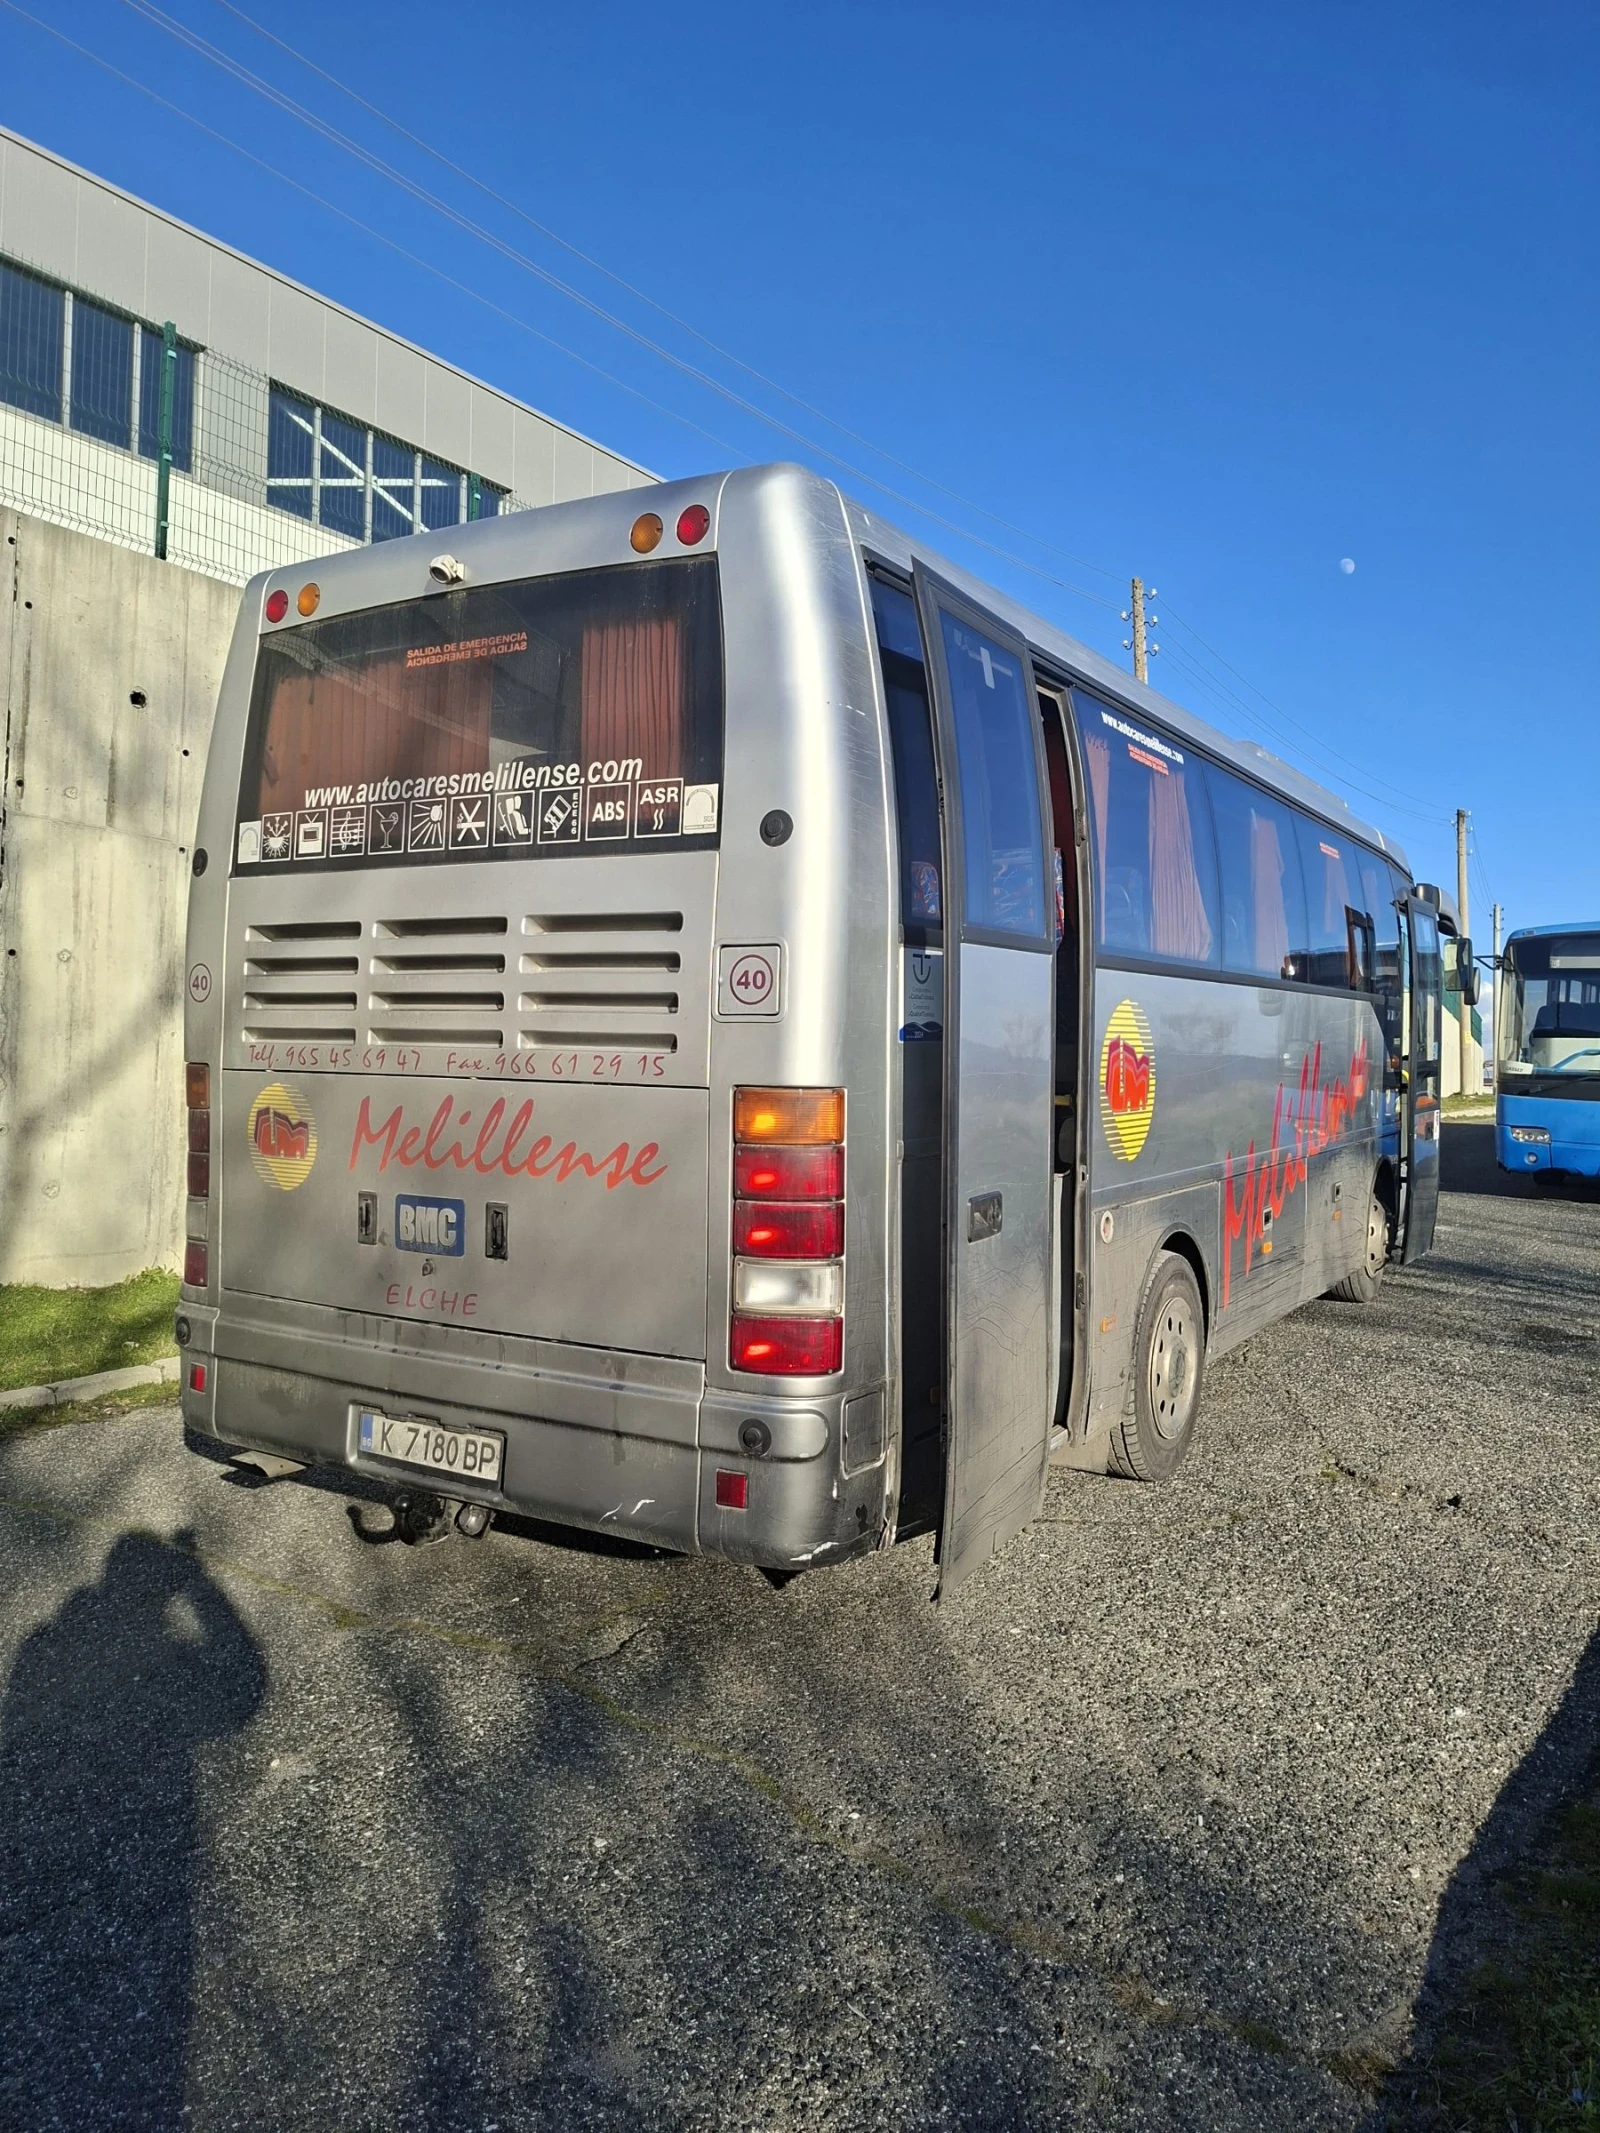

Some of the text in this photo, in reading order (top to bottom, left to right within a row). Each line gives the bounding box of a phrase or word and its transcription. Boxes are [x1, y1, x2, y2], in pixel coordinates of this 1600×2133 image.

[406, 631, 528, 659] SALIDA DE EMERGENCIA
[304, 757, 643, 809] www.autocaresmelillense.com
[639, 786, 679, 806] ASR
[591, 800, 625, 823] ABS
[192, 974, 208, 991] 40
[736, 969, 766, 990] 40
[286, 1045, 320, 1067] 965
[329, 1048, 351, 1069] 45
[362, 1048, 386, 1069] 69
[397, 1048, 421, 1072] 47
[446, 1052, 490, 1074] Fax.
[495, 1052, 536, 1075] 966
[551, 1053, 578, 1075] 61
[592, 1054, 622, 1078] 29
[637, 1054, 666, 1077] 15
[348, 1093, 669, 1191] Melillense
[399, 1204, 457, 1248] BMC
[386, 1283, 478, 1316] ELCHE
[362, 1436, 372, 1447] BG
[381, 1421, 395, 1454] K
